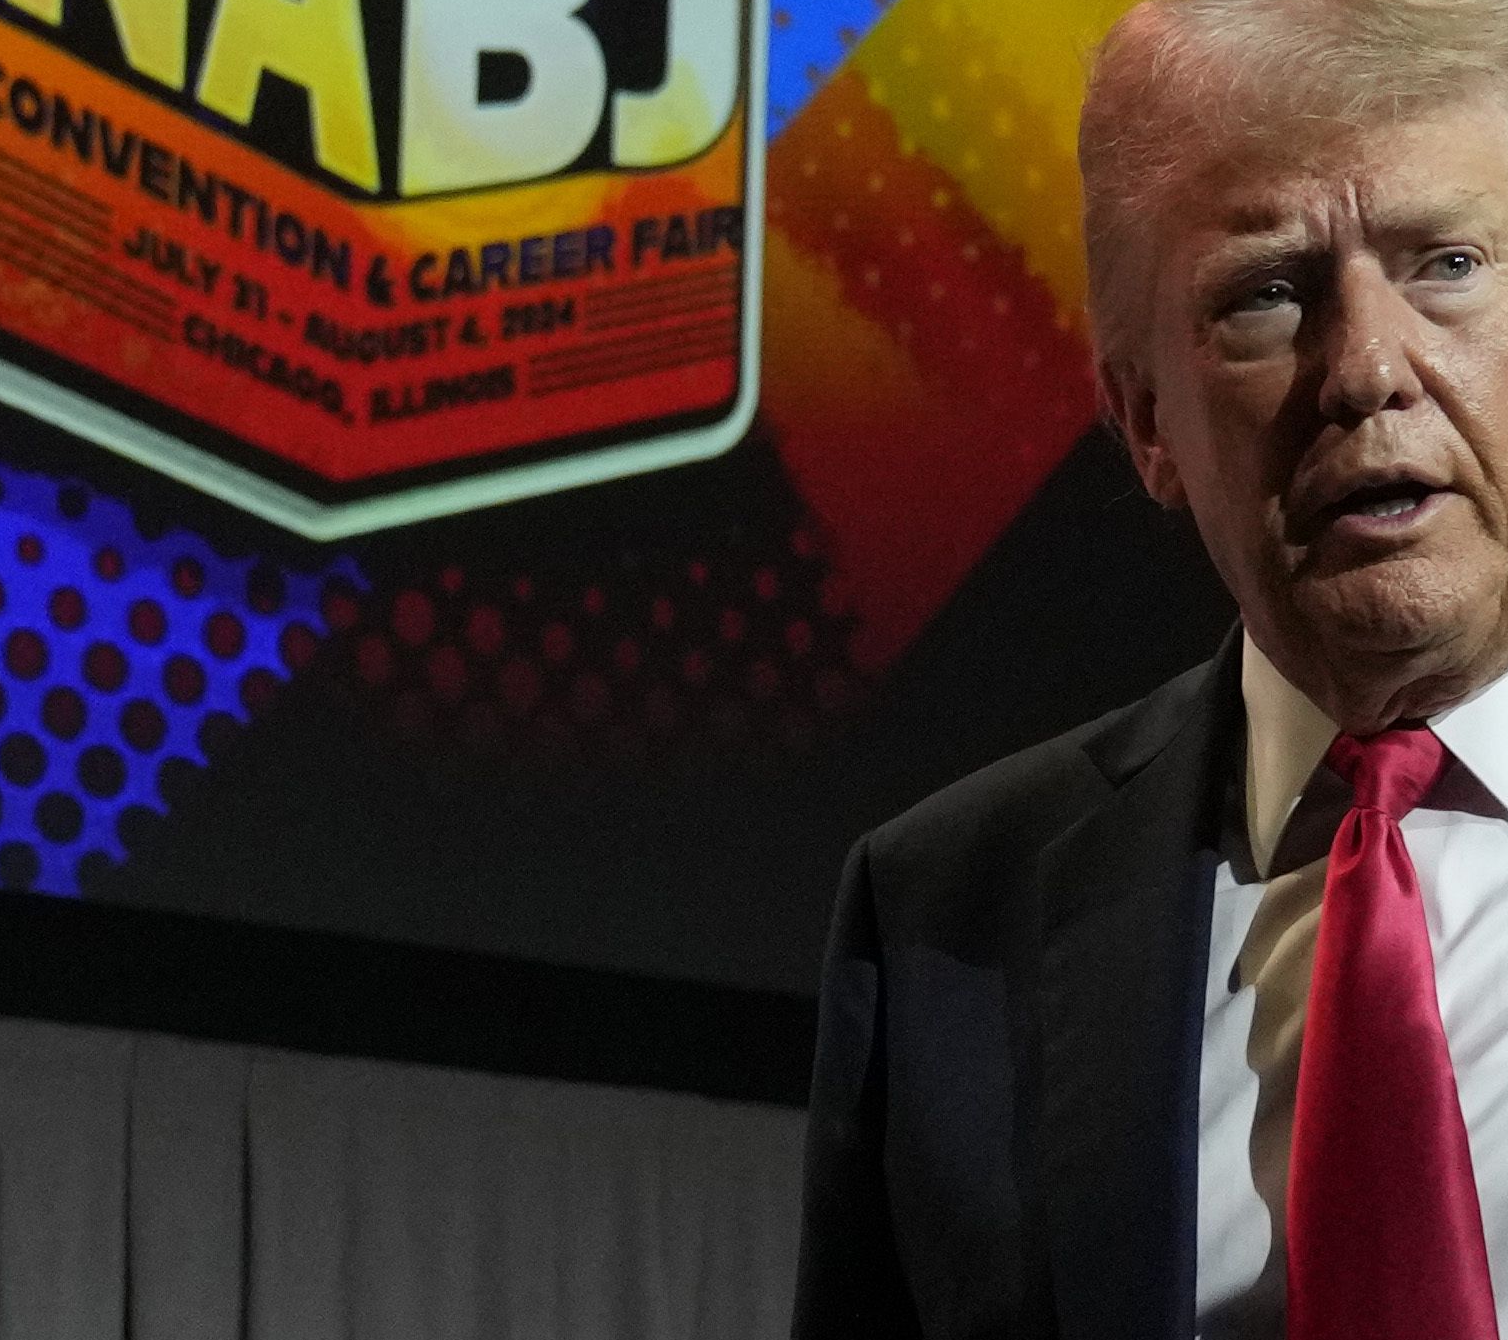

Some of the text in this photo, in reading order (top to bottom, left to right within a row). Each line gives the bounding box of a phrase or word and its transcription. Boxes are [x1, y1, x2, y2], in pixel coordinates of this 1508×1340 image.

[121, 226, 224, 295] JULY
[303, 312, 450, 365] AUGUST
[501, 296, 577, 343] 2024
[365, 253, 396, 309] &
[408, 223, 620, 303] CAREER
[630, 204, 744, 269] FAIR
[182, 312, 516, 429] CHICAGO, ILLINOIS
